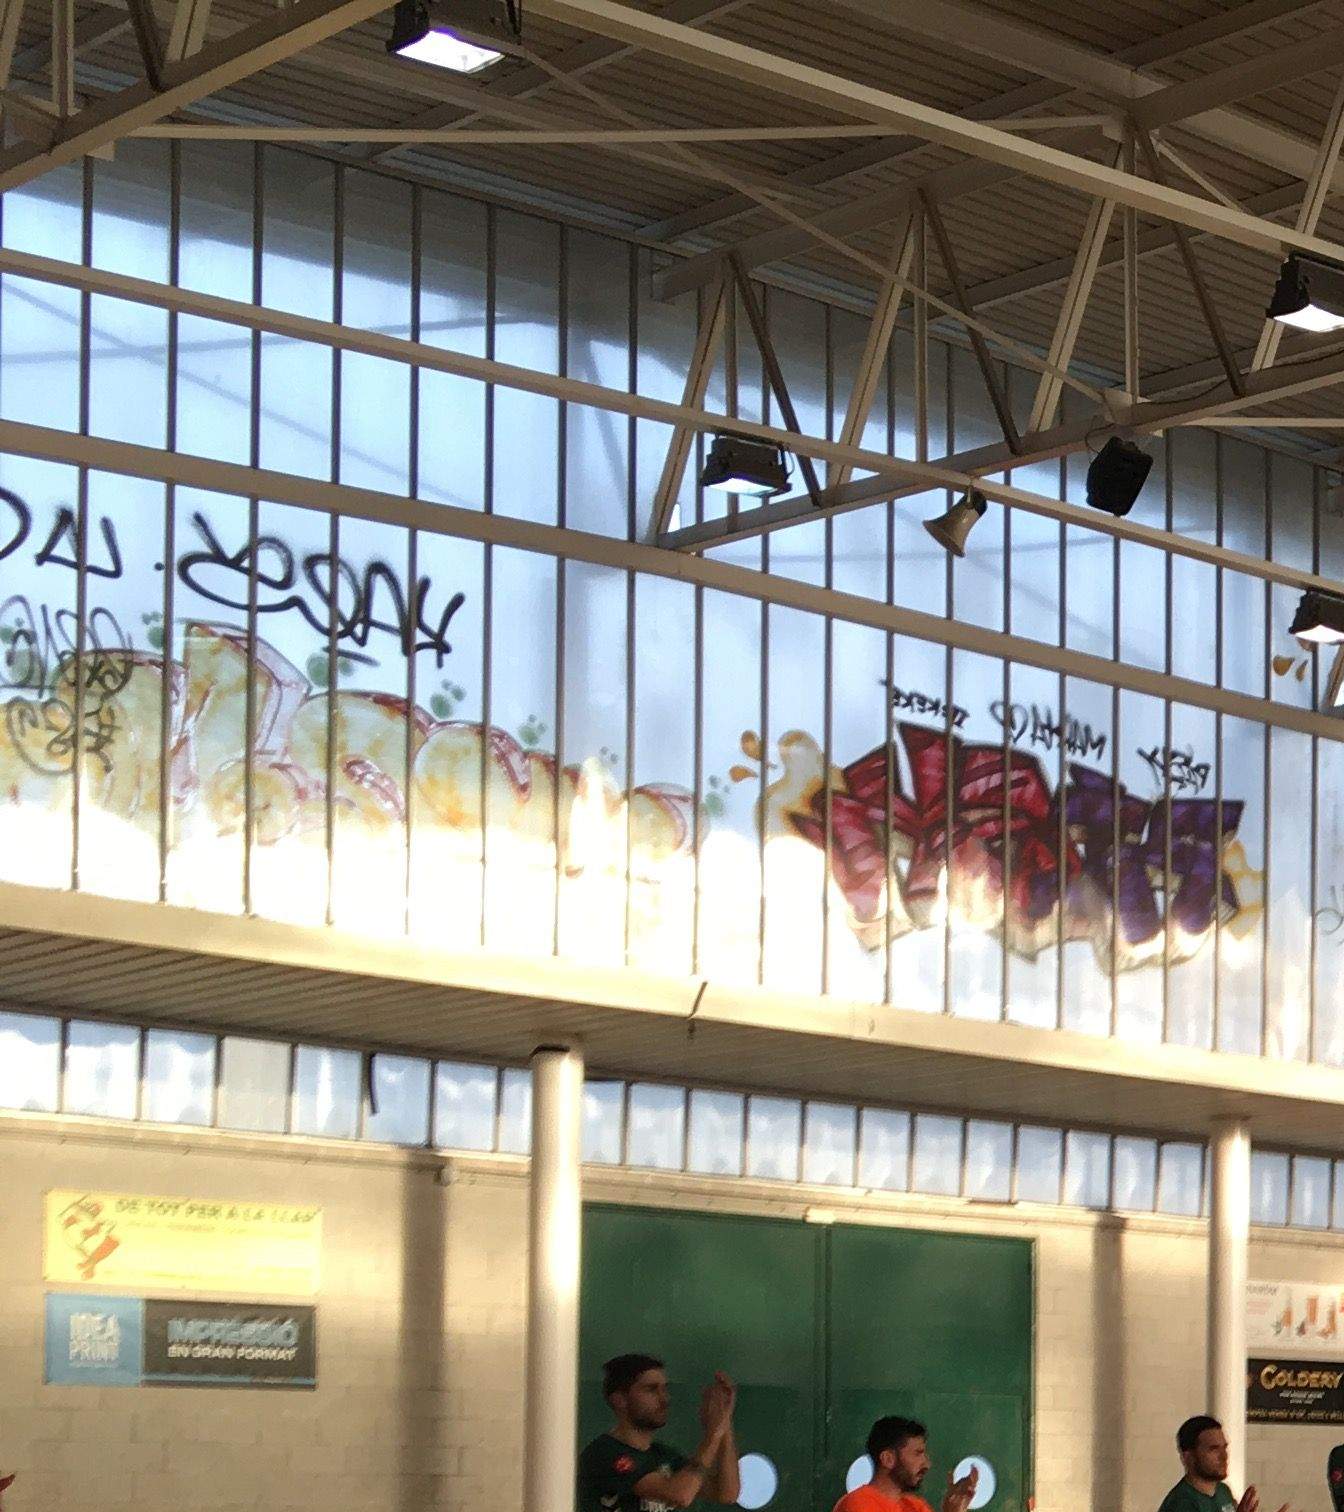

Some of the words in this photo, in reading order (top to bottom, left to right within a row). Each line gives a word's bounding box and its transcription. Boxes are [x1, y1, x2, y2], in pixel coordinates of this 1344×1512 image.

[167, 1344, 190, 1359] EN
[191, 1345, 235, 1360] GRAN
[236, 1346, 298, 1362] FORMAT
